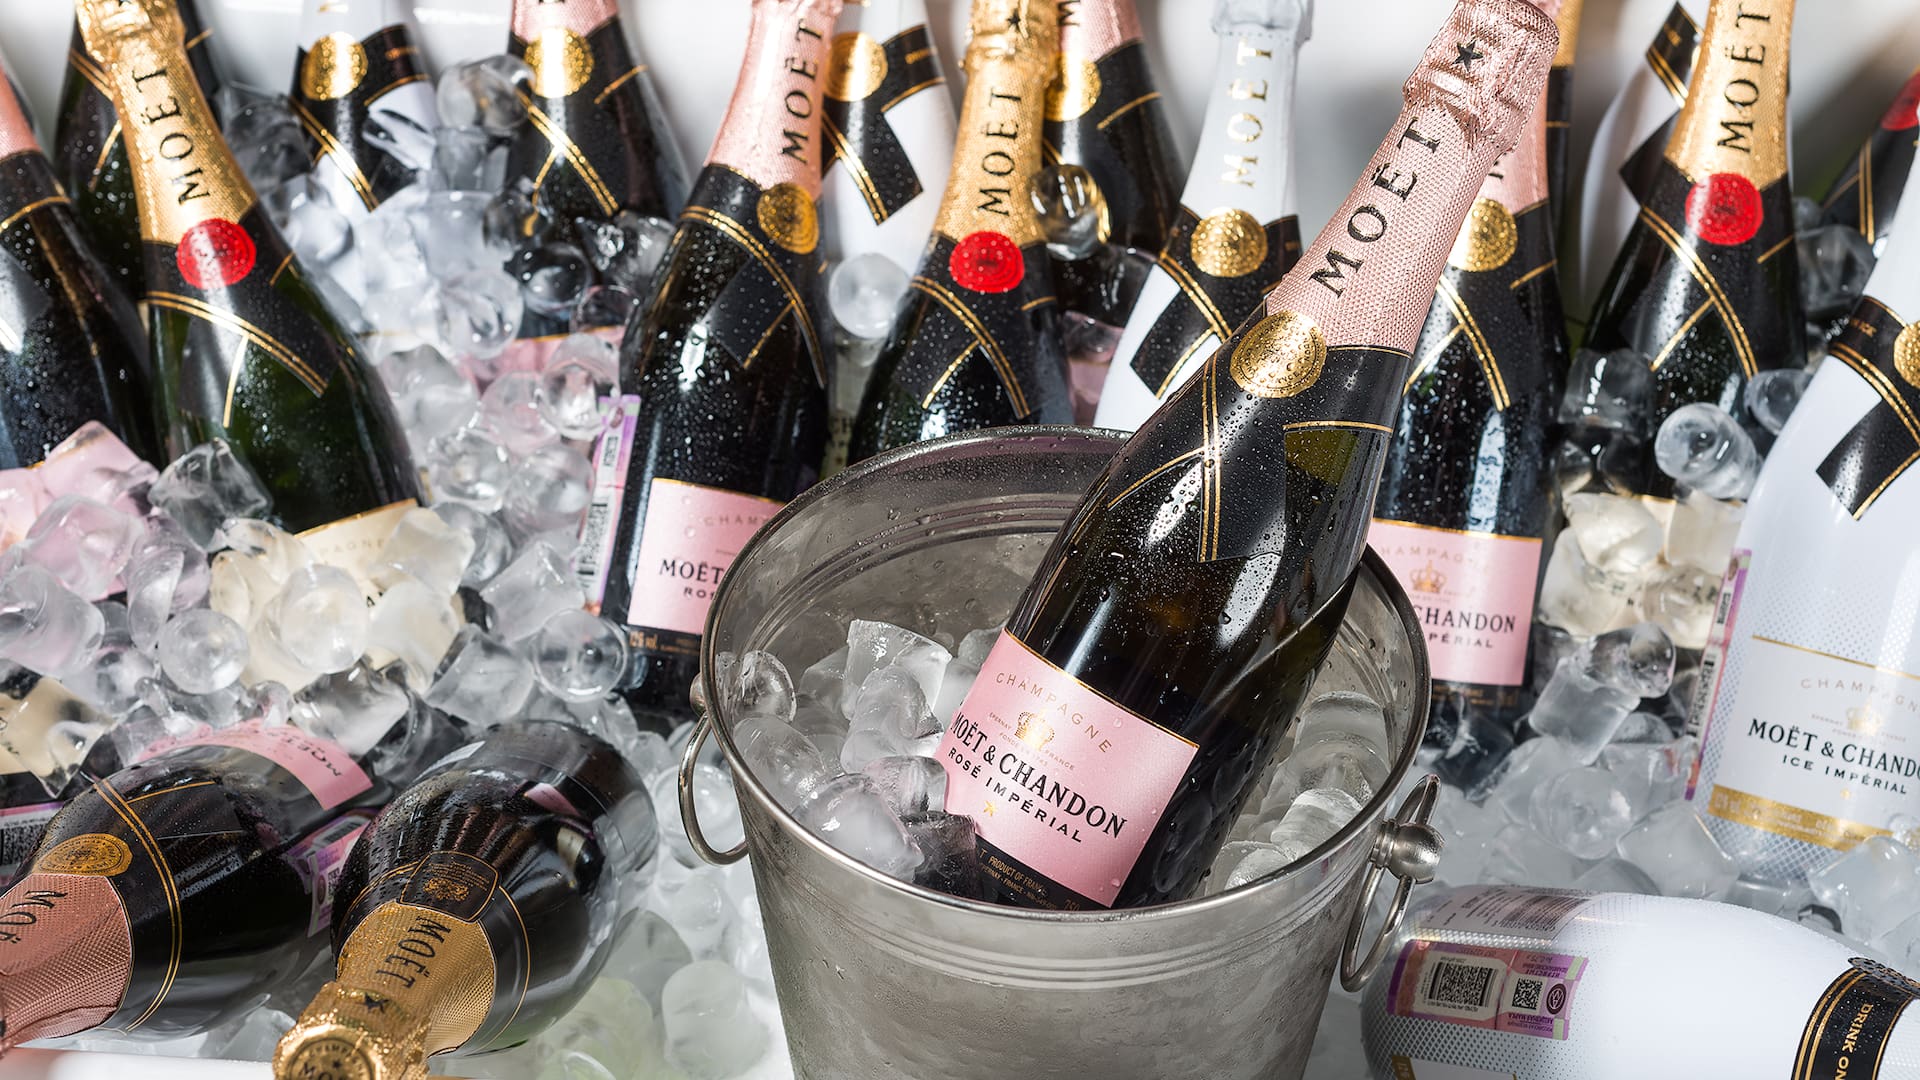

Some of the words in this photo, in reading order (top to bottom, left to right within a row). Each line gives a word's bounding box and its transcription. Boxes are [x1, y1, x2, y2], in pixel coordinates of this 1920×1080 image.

[780, 18, 823, 165] MOËT
[1219, 36, 1273, 188] MOËT
[1717, 2, 1771, 153] MOËT
[131, 67, 211, 206] MOËT
[977, 86, 1022, 217] MOËT
[1308, 116, 1441, 299] MOËT
[995, 672, 1113, 753] CHAMPAGNE
[1748, 718, 1818, 752] MOËT
[1821, 741, 1835, 759] &
[948, 747, 982, 779] ROSÉ
[985, 777, 1083, 844] IMPÉRIAL
[950, 712, 988, 754] MOËT
[983, 744, 998, 766] &
[999, 753, 1128, 840] CHANDON
[1782, 755, 1815, 771] ICE
[1825, 766, 1908, 796] IMPÉRIAL
[988, 855, 1017, 878] PRODUCT
[375, 916, 452, 988] MOËT
[1841, 1003, 1874, 1053] DRINK
